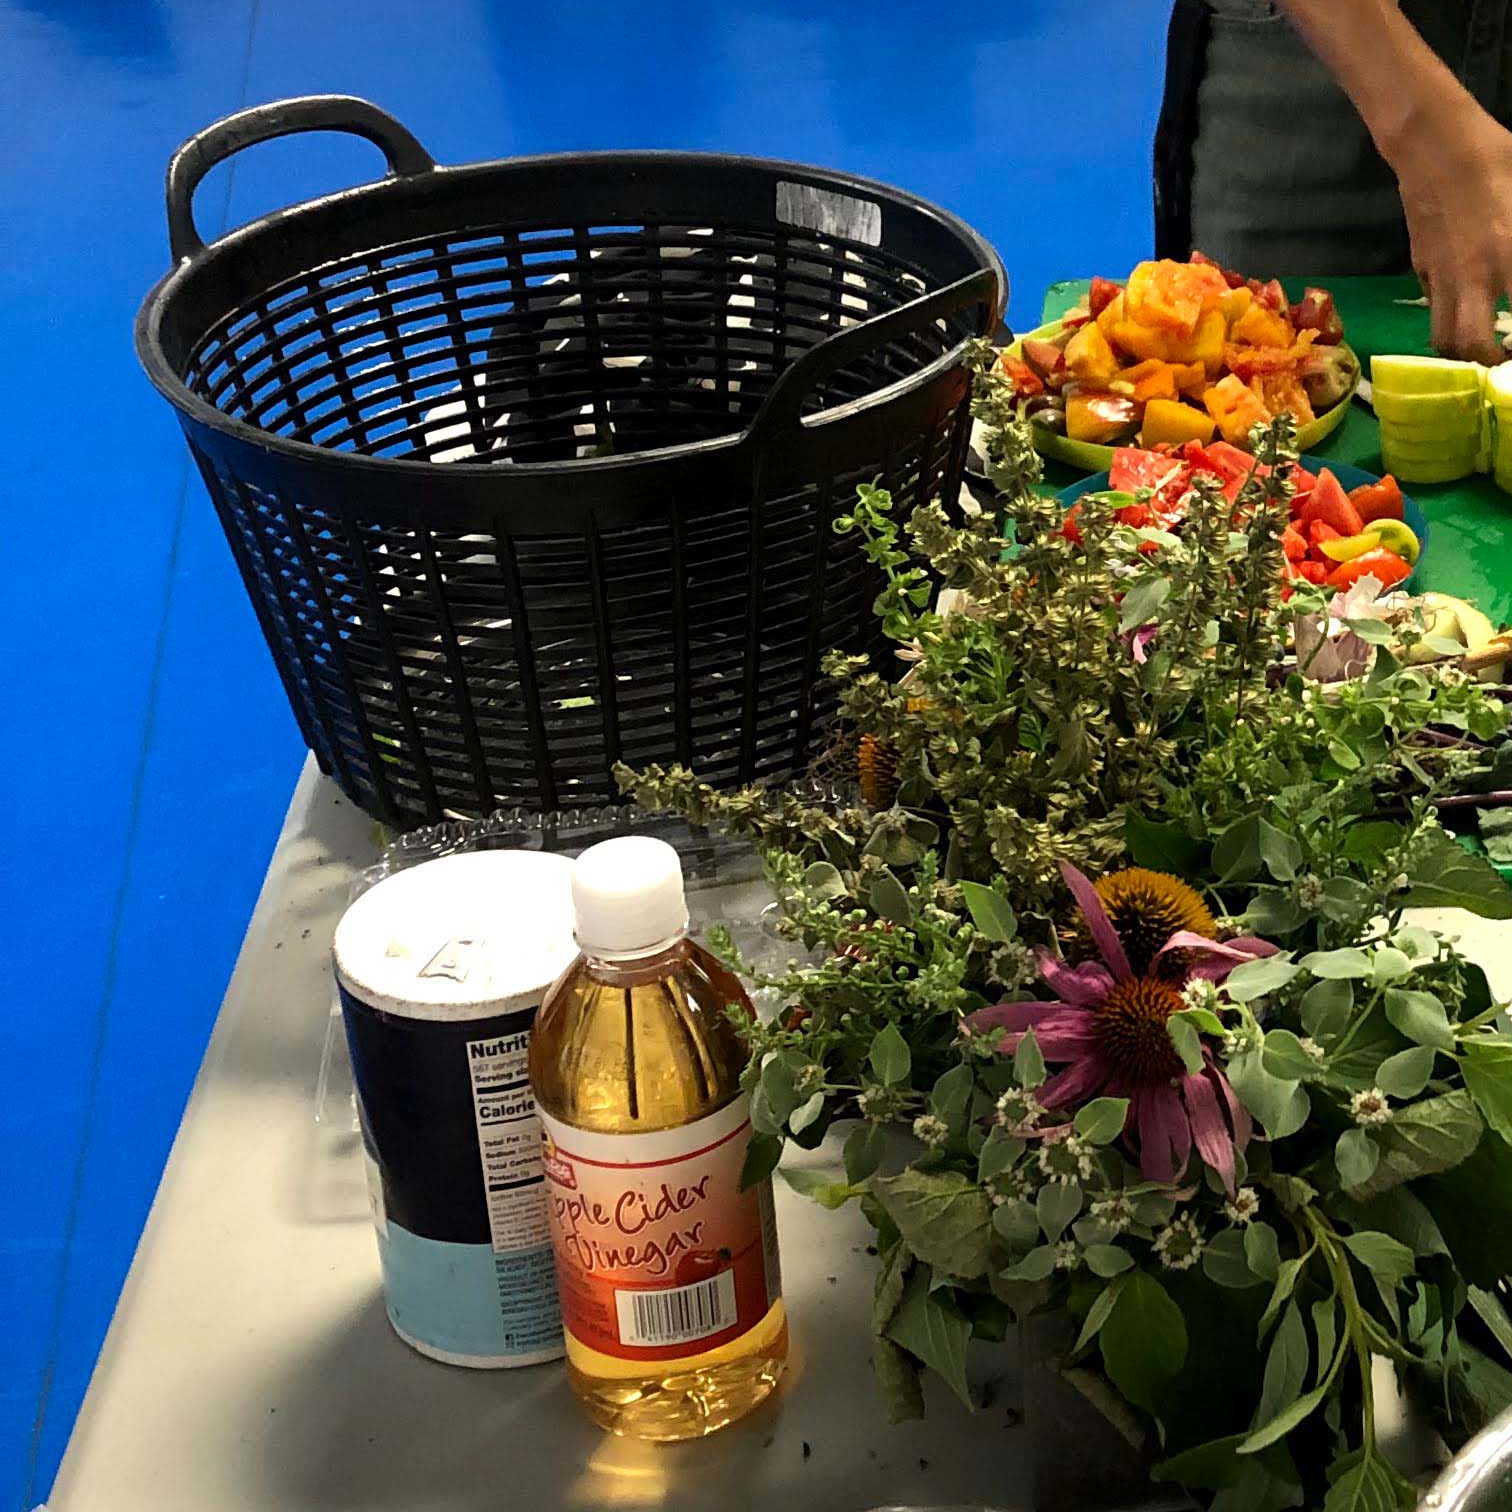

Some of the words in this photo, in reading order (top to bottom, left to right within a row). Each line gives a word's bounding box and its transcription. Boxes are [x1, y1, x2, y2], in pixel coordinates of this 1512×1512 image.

[470, 1034, 529, 1059] Nutrit
[613, 1175, 712, 1236] Cider
[564, 1220, 707, 1275] Vinegar
